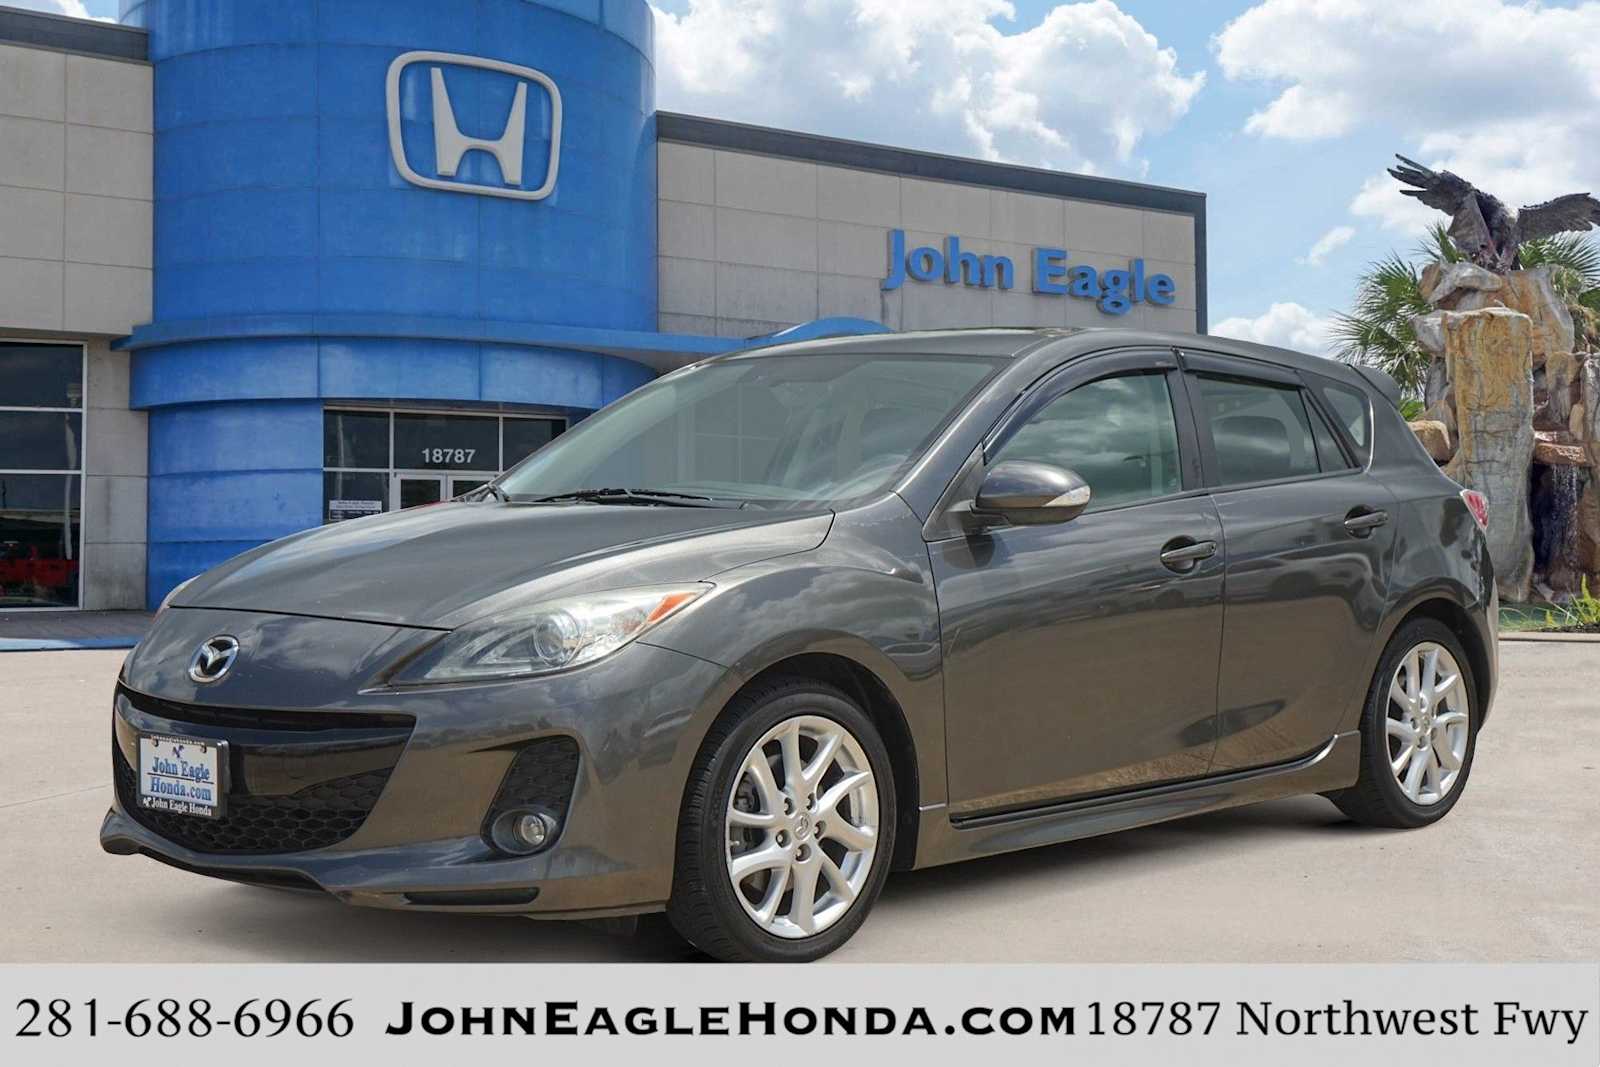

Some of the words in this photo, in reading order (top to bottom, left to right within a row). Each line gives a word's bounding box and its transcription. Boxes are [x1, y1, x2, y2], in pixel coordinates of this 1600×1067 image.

[880, 229, 1014, 290] John
[1032, 247, 1176, 315] Eagle
[421, 449, 476, 463] 18787
[152, 757, 178, 776] John
[180, 760, 210, 783] Eagle
[150, 777, 212, 801] Honda.com
[152, 797, 168, 808] John
[169, 800, 188, 814] Eagle
[189, 803, 212, 816] Honda
